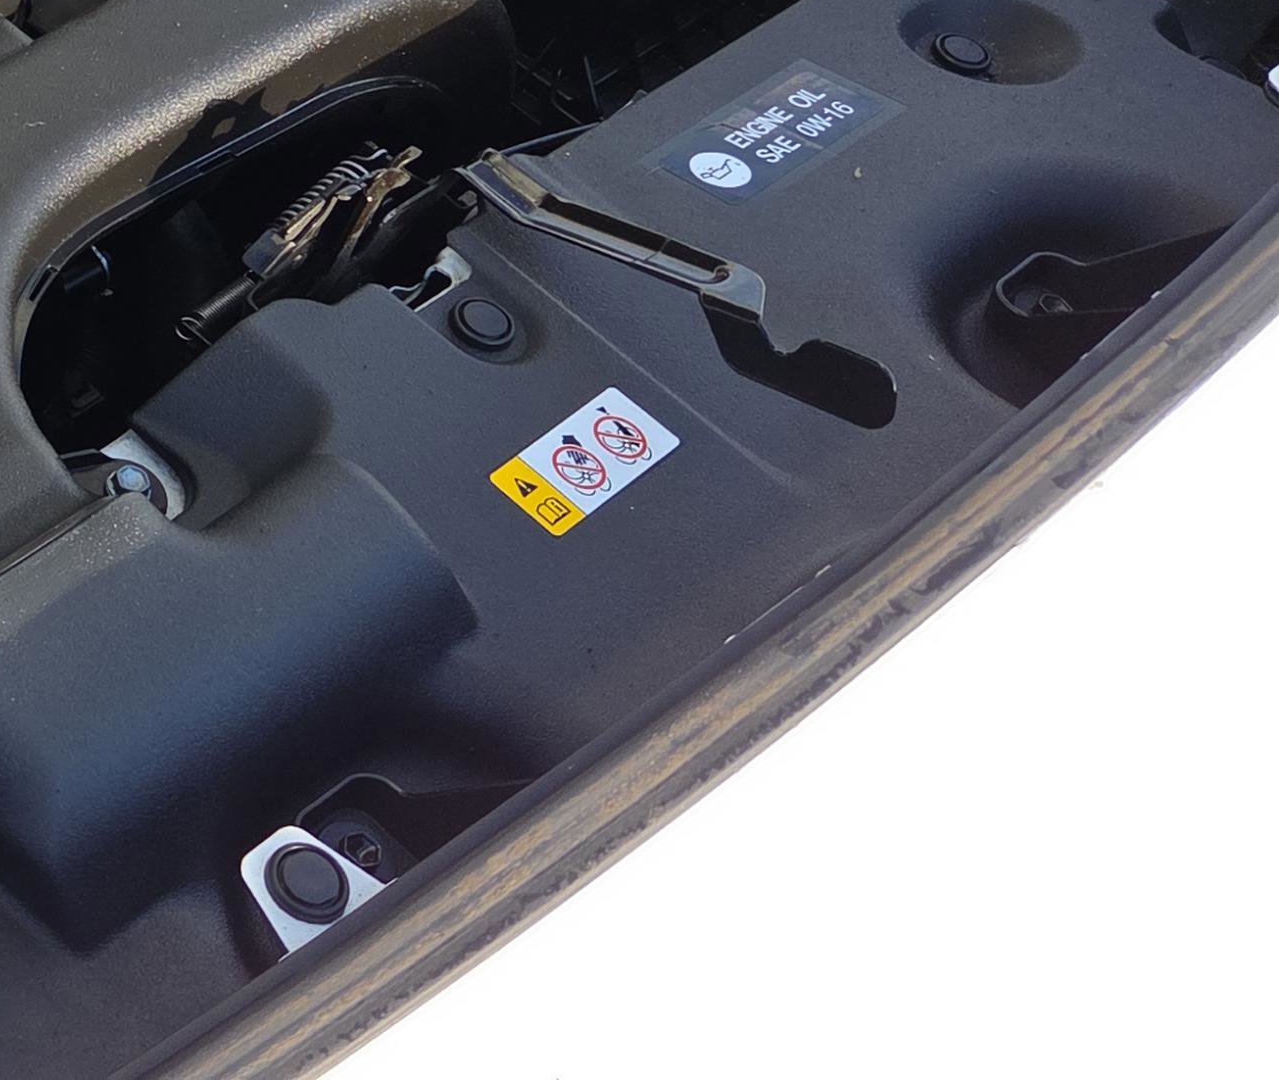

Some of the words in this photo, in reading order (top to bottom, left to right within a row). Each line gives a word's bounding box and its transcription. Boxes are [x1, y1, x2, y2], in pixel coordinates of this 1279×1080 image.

[724, 106, 794, 149] ENGINE
[788, 89, 826, 108] OIL
[755, 135, 801, 164] SAE
[795, 101, 854, 138] 0W-16
